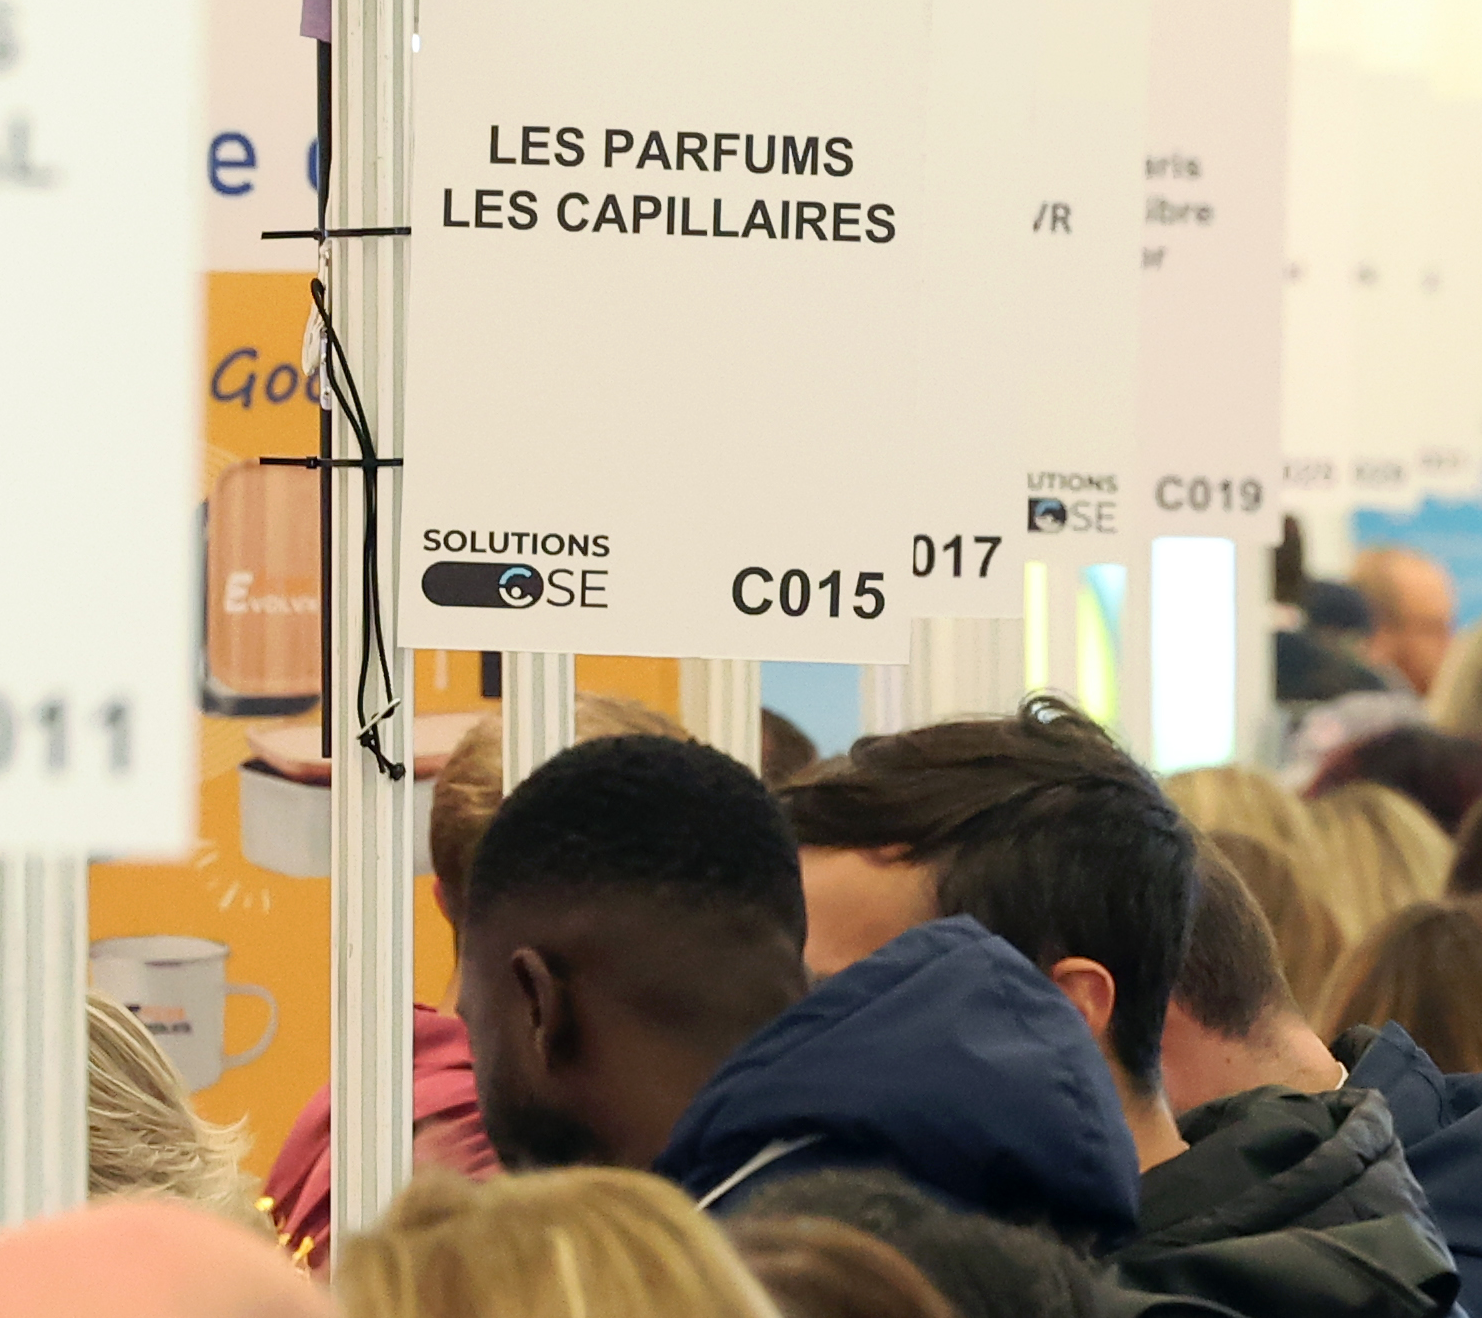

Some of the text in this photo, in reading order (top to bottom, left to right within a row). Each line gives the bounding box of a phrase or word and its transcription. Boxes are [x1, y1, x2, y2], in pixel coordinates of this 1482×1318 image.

[489, 124, 854, 178] LES PARFUMS
[442, 187, 896, 244] LES CAPILLAIRES
[1154, 475, 1264, 513] C019
[423, 528, 610, 558] SOLUTIONS
[912, 534, 1002, 578] 017
[731, 566, 886, 620] C015
